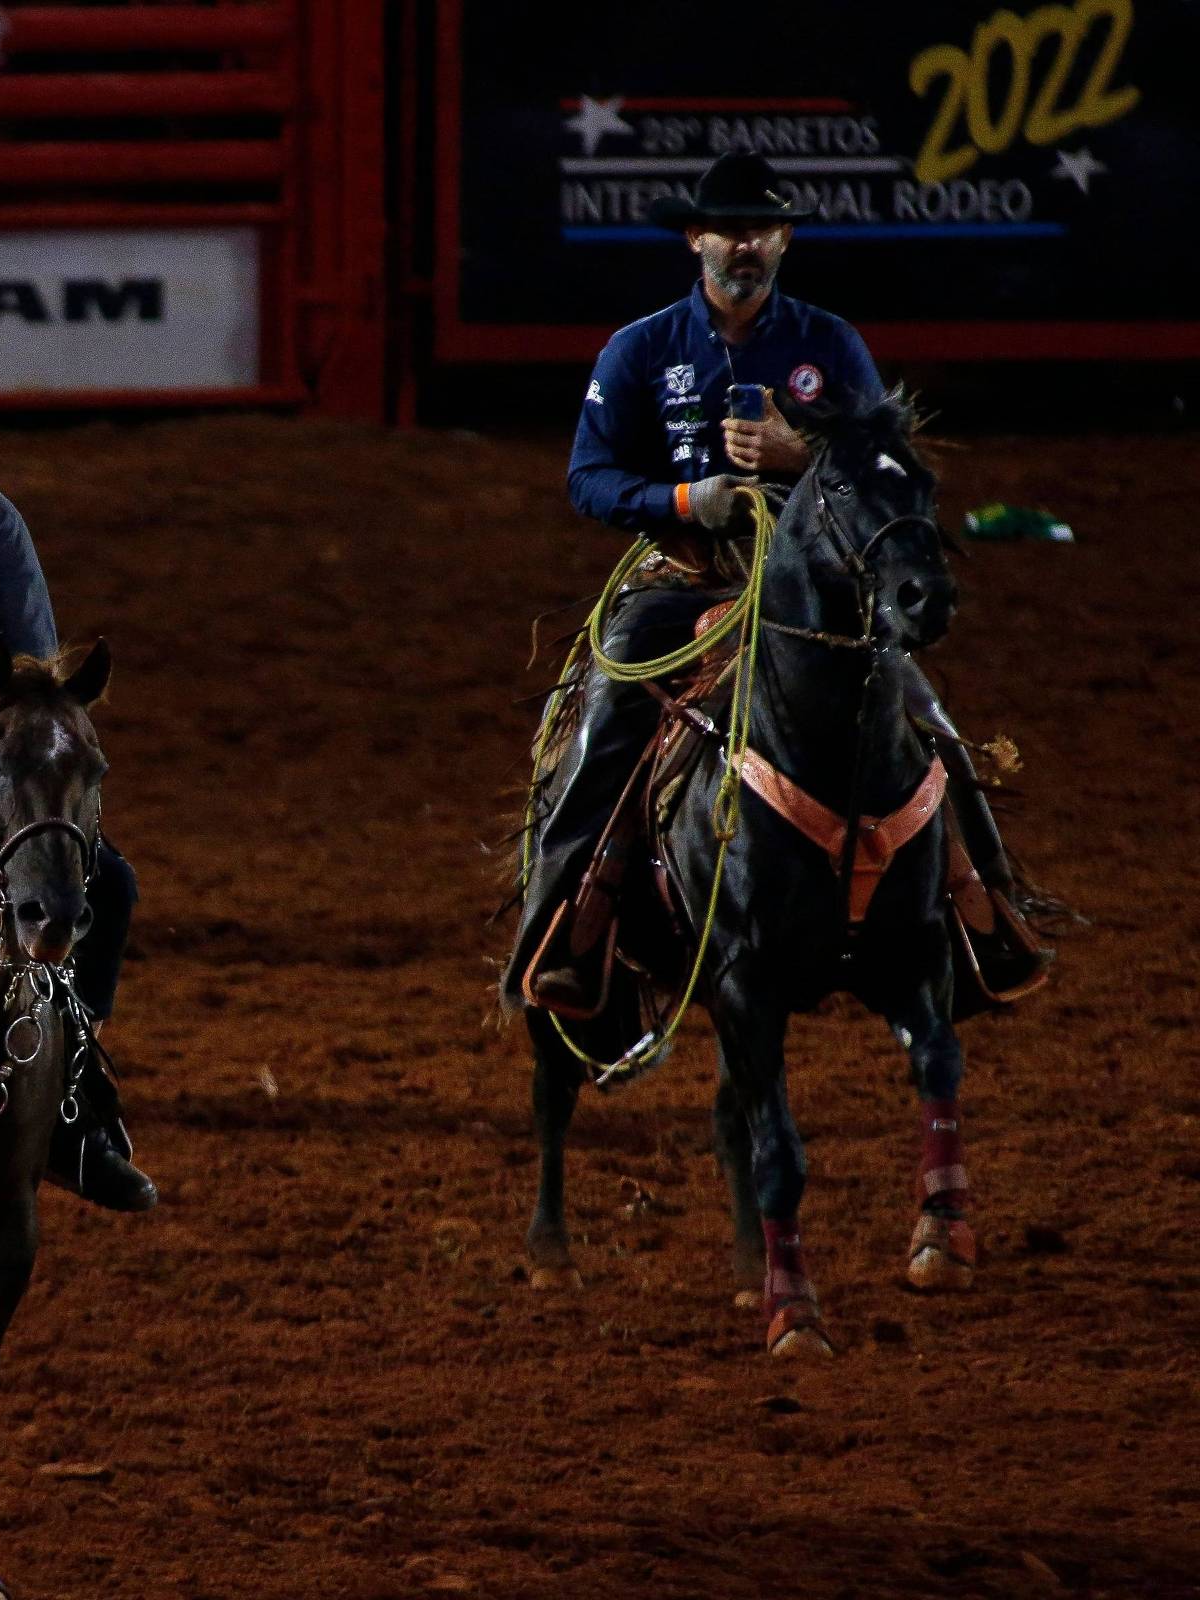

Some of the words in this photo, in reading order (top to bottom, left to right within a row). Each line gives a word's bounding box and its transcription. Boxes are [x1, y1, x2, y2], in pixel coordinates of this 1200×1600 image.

[909, 0, 1141, 185] 2022
[708, 115, 881, 155] BARRETOS
[891, 178, 1034, 223] RODEO
